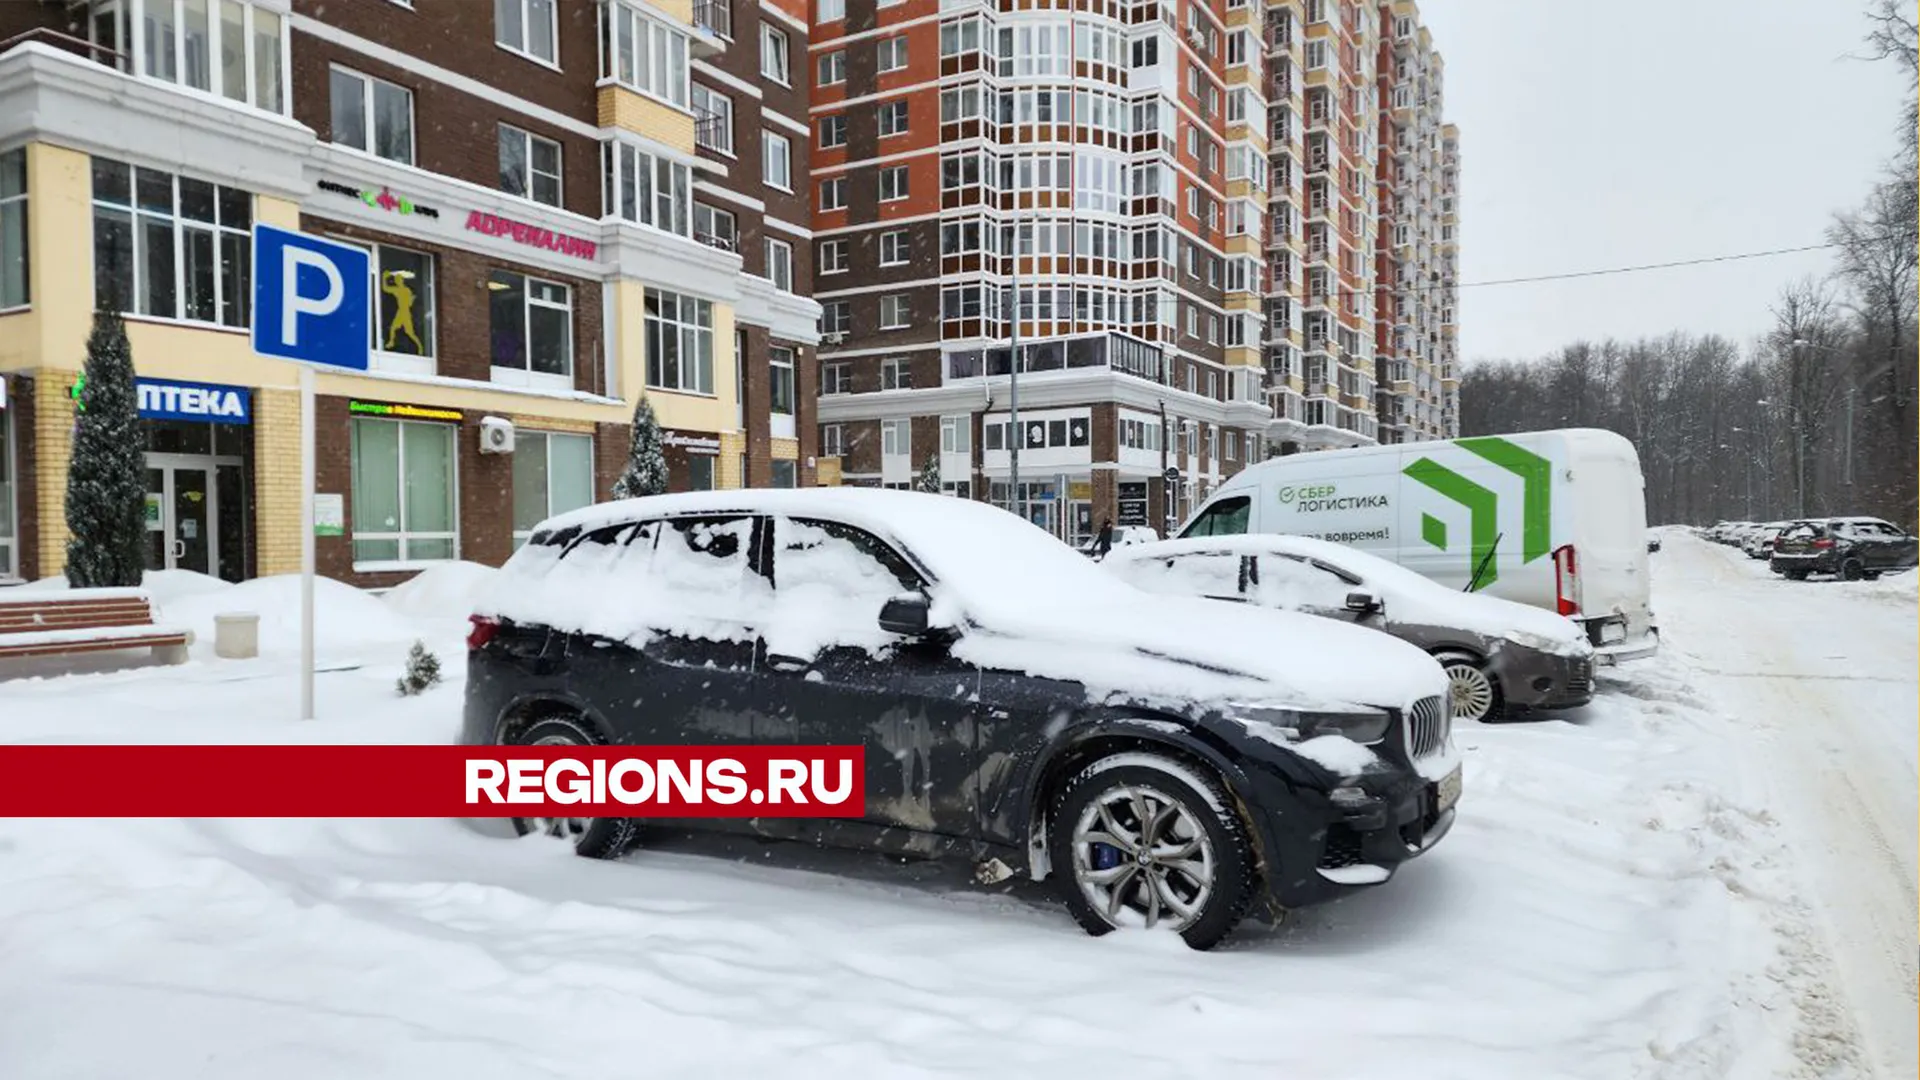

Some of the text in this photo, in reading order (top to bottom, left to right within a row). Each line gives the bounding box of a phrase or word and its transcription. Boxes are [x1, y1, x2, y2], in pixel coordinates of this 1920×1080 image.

[465, 209, 597, 261] АДРЕНАЛИН
[136, 384, 244, 417] ПТЕКА
[1298, 486, 1336, 499] СБЕР
[1297, 495, 1389, 513] ЛОГИСТИКА
[1325, 527, 1390, 543] вовремя!
